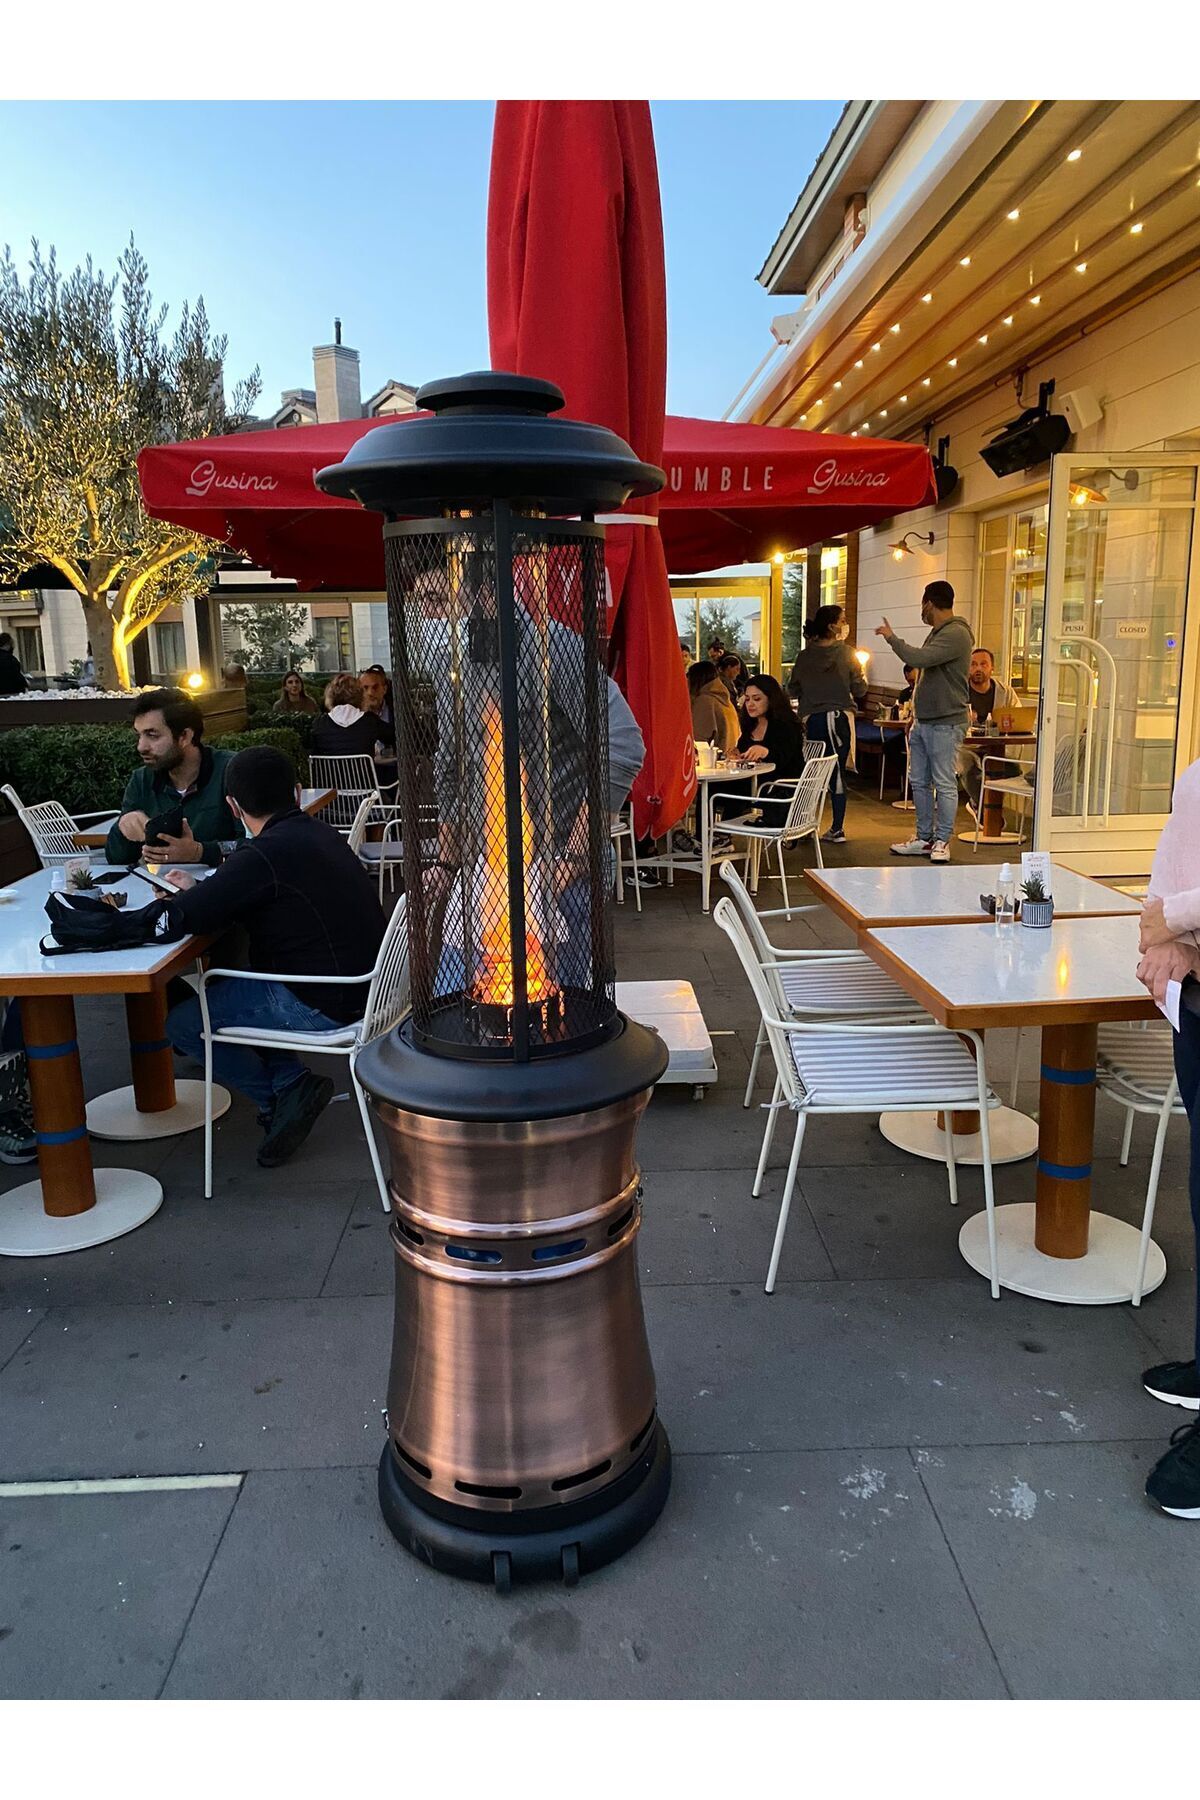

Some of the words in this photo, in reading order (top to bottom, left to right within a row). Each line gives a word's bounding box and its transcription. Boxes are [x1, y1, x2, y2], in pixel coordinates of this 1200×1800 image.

[185, 460, 279, 497] Gusina
[670, 466, 774, 492] UMBLE
[807, 459, 891, 495] Gusina
